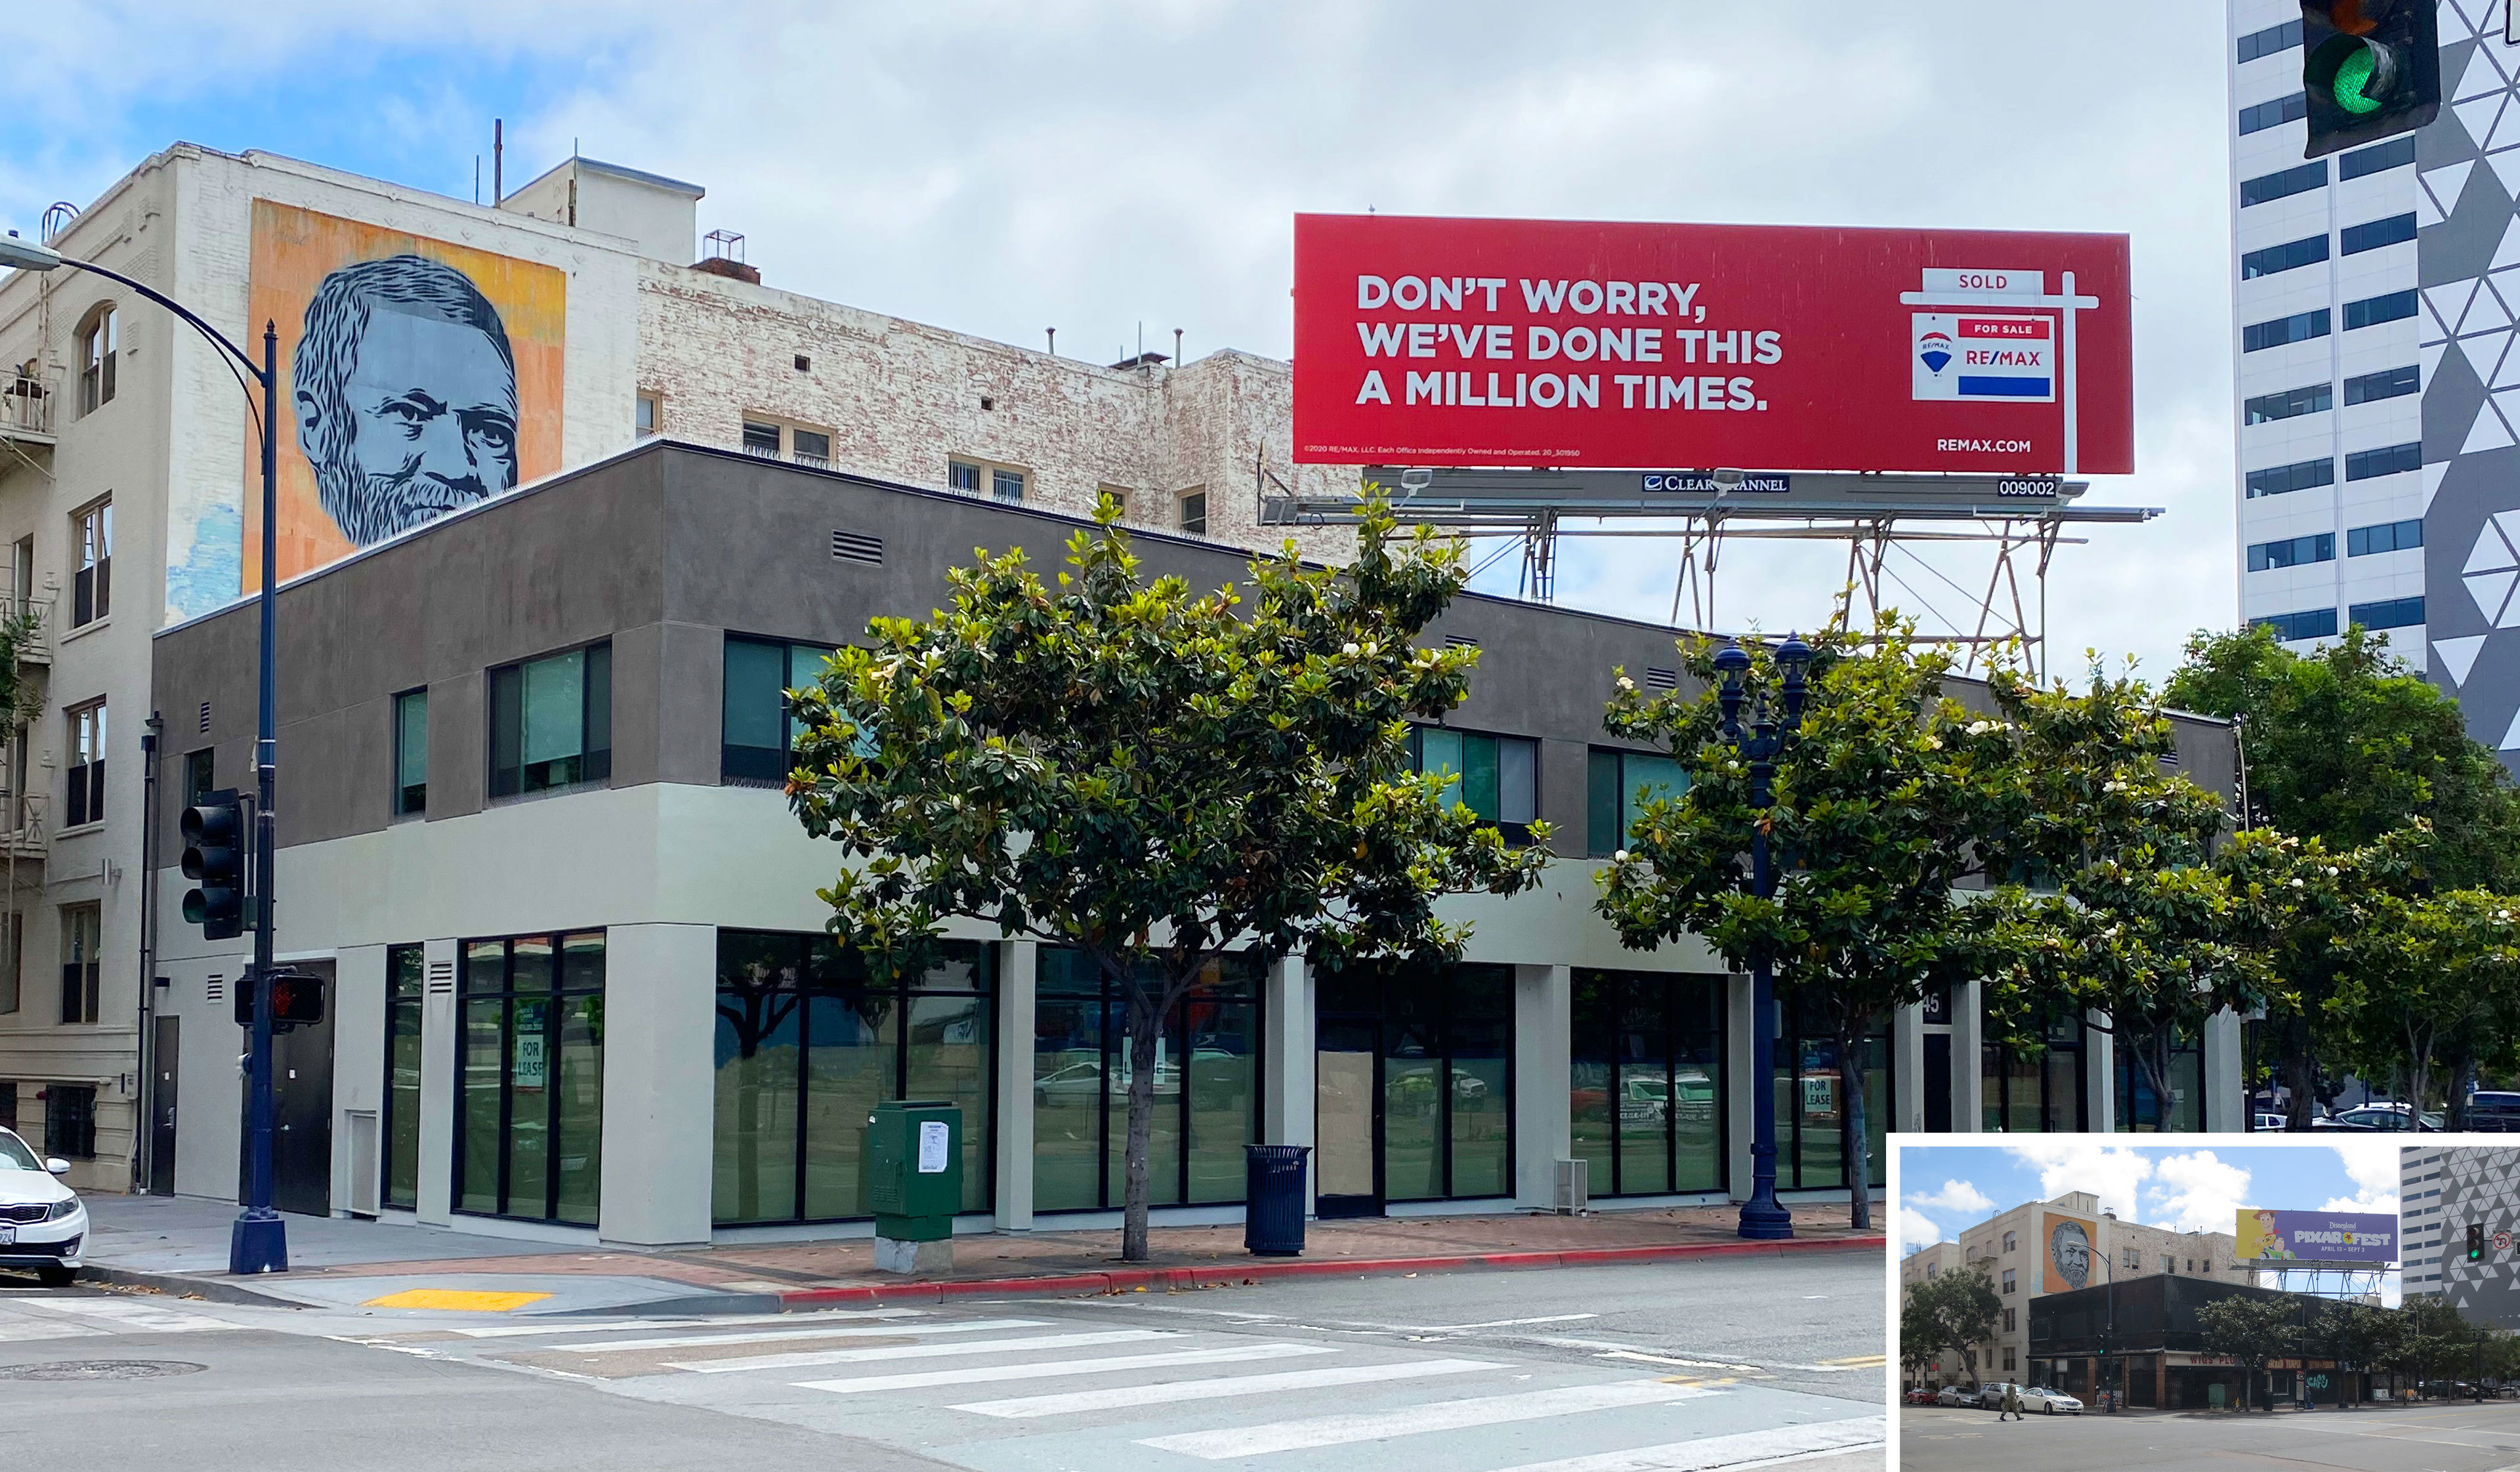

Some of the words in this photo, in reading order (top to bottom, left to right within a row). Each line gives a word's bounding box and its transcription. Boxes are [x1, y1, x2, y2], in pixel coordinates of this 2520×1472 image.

[1959, 274, 2007, 289] SOLD
[1357, 274, 1507, 312] DON’T
[1519, 278, 1707, 324] WORRY,
[1974, 324, 1998, 333] FOR
[2002, 325, 2032, 334] SALE
[1356, 322, 1513, 360] WE’VE
[1528, 326, 1662, 363] DONE
[1675, 329, 1782, 365] THIS
[1923, 342, 1950, 350] RE/MAX
[1966, 350, 2041, 366] RE/MAX
[1355, 369, 1391, 405] A
[1406, 371, 1600, 409] MILLION
[1614, 375, 1767, 411] TIMES.
[1937, 438, 2031, 453] REMAX.COM
[2000, 481, 2055, 495] 009002
[523, 1042, 539, 1057] FOR
[518, 1061, 543, 1076] LEASE
[1810, 1080, 1826, 1091] FOR
[1806, 1094, 1830, 1105] LEASE
[2328, 1221, 2357, 1230] Disneyland
[2190, 1355, 2214, 1364] WIGS
